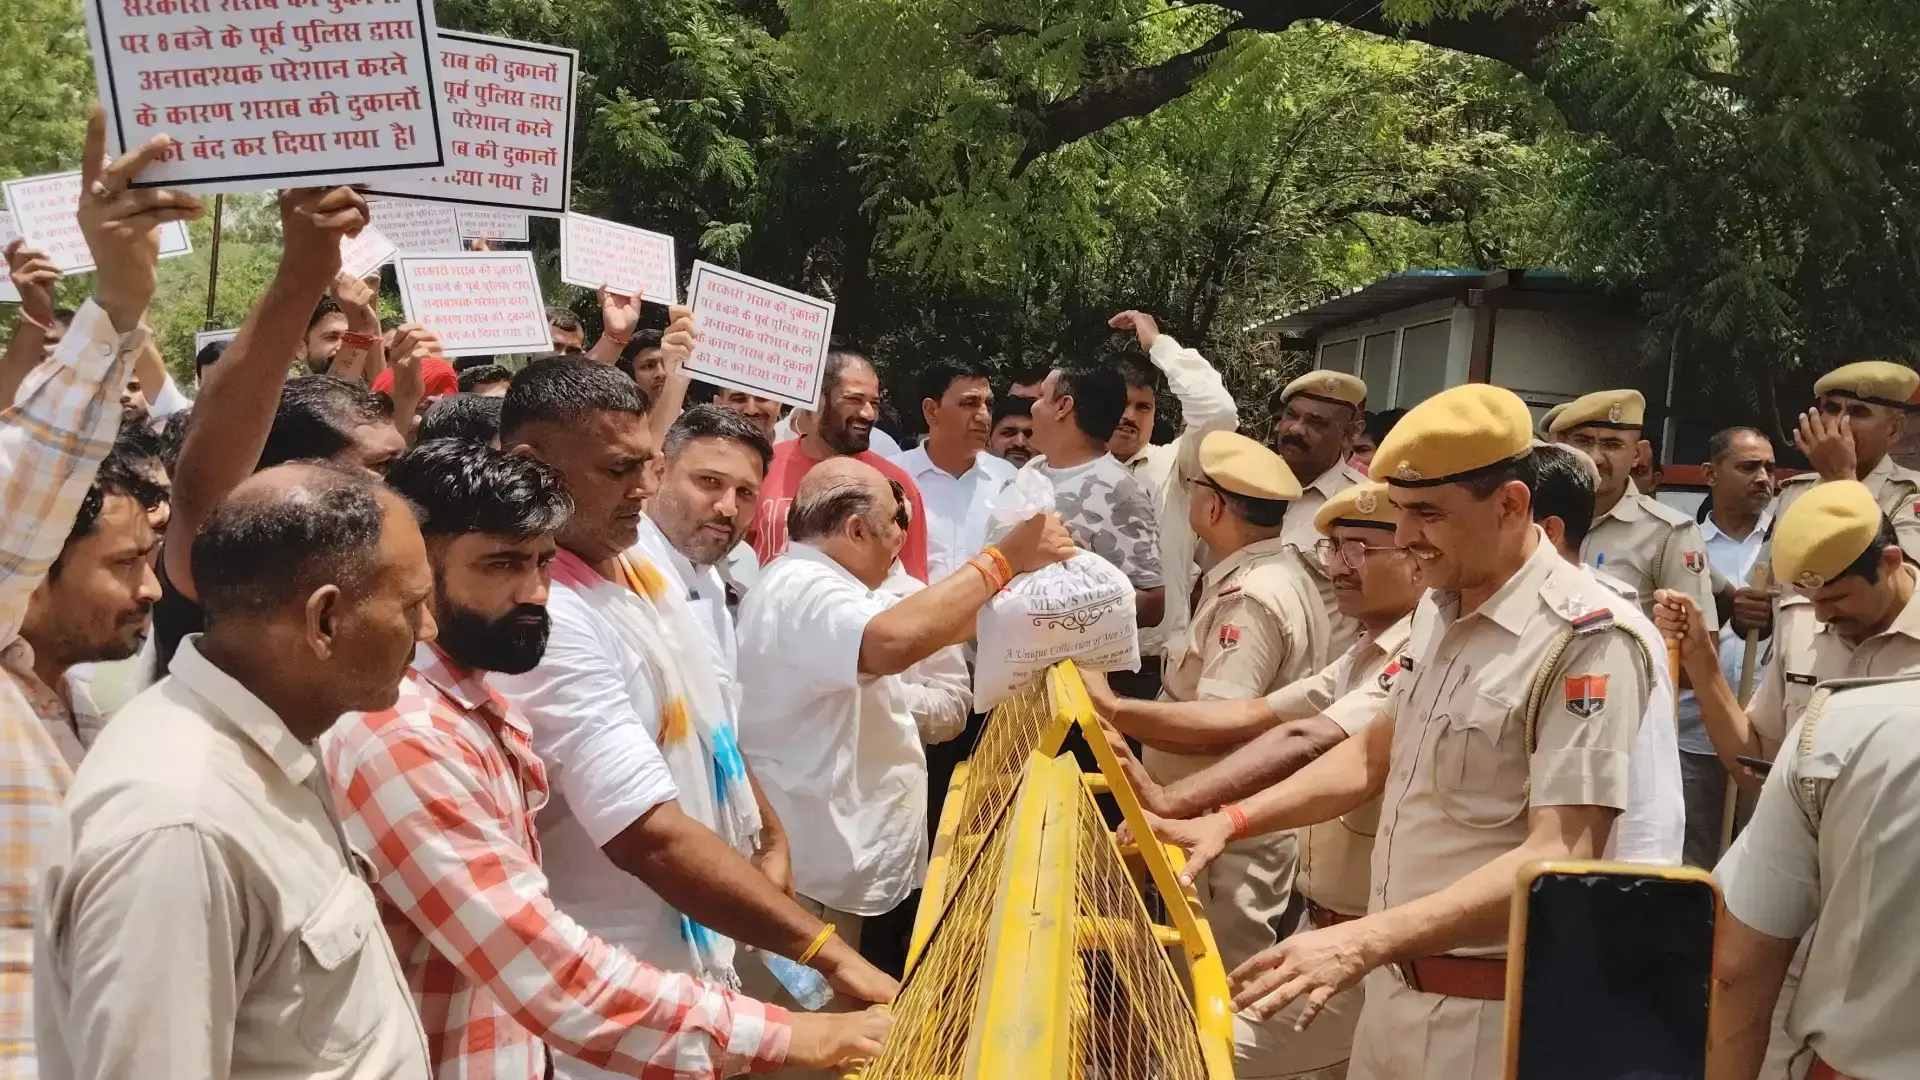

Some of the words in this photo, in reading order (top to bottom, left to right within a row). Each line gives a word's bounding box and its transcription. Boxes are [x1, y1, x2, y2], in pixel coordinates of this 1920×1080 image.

[119, 34, 150, 54] पर
[219, 24, 243, 48] के
[249, 20, 286, 55] पूर्व
[292, 19, 362, 52] पुलिस
[138, 64, 263, 91] अनावश्यक
[270, 57, 350, 82] परेशान
[355, 51, 408, 76] करने
[440, 51, 470, 70] राब
[475, 53, 499, 74] की
[504, 60, 559, 83] दुकानों
[133, 102, 158, 127] के
[164, 102, 234, 125] कारण
[240, 98, 302, 120] शराब
[307, 90, 340, 116] की
[346, 85, 422, 121] दुकानों
[444, 79, 470, 105] पूर्व
[474, 83, 525, 108] पुलिस
[452, 109, 511, 133] परेशान
[516, 118, 553, 138] करने
[190, 135, 225, 160] बंद
[230, 136, 267, 156] कर
[272, 130, 327, 154] दिया
[332, 129, 380, 150] गया
[475, 139, 499, 160] की
[503, 146, 558, 168] दुकानों
[488, 172, 523, 190] गया
[1030, 594, 1079, 611] MEN'S
[1016, 646, 1048, 661] Unique
[1050, 639, 1091, 656] Collection
